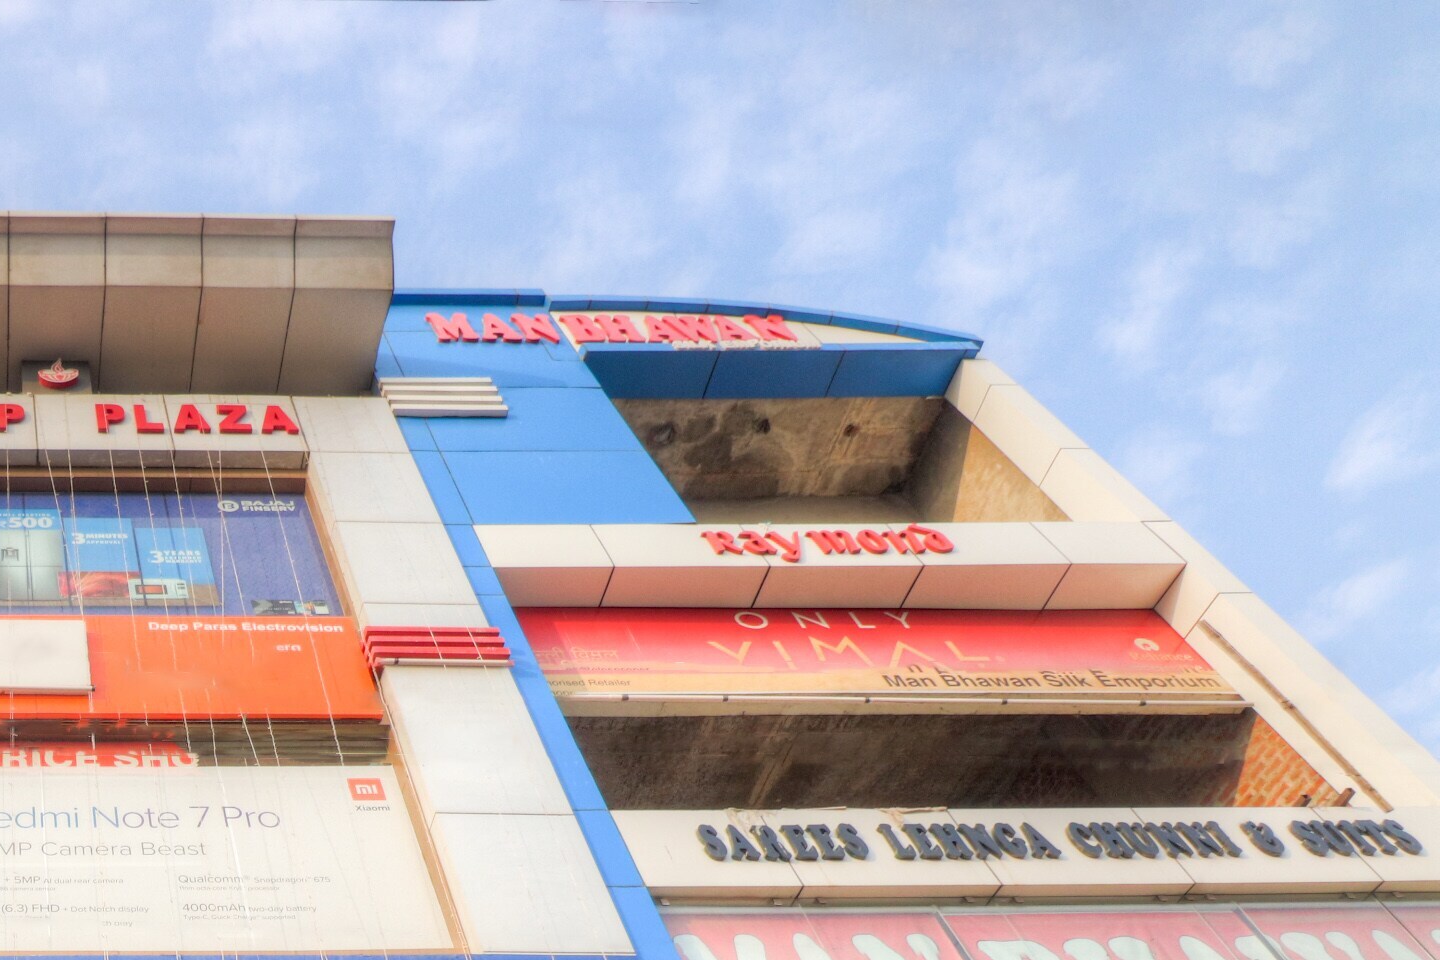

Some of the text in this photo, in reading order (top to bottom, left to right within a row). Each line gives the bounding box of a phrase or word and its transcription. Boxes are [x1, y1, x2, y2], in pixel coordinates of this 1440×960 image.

[425, 312, 798, 344] MAN BHAWAN
[95, 402, 299, 435] PLAZA
[71, 532, 128, 545] 3 MINUTES
[150, 550, 163, 563] 3
[148, 621, 344, 633] Deep Paras Electrovision
[734, 610, 910, 630] ONLY
[707, 636, 991, 672] VIMAL
[882, 670, 1223, 692] Man Bhawan Silk Emporium
[92, 806, 180, 830] Note
[188, 806, 210, 829] 7
[221, 806, 281, 829] Pro
[40, 841, 136, 858] Camera
[140, 840, 208, 857] Beast
[695, 822, 869, 862] SAREES
[877, 821, 1062, 860] LEHNGA
[1068, 819, 1242, 860] CHUNNI
[1288, 817, 1427, 857] SUITS
[14, 876, 41, 884] 5MP
[1, 903, 29, 914] (6.3)
[32, 904, 60, 913] FHD
[117, 905, 149, 914] display
[182, 903, 246, 912] 4000mAh
[286, 904, 317, 913] battery
